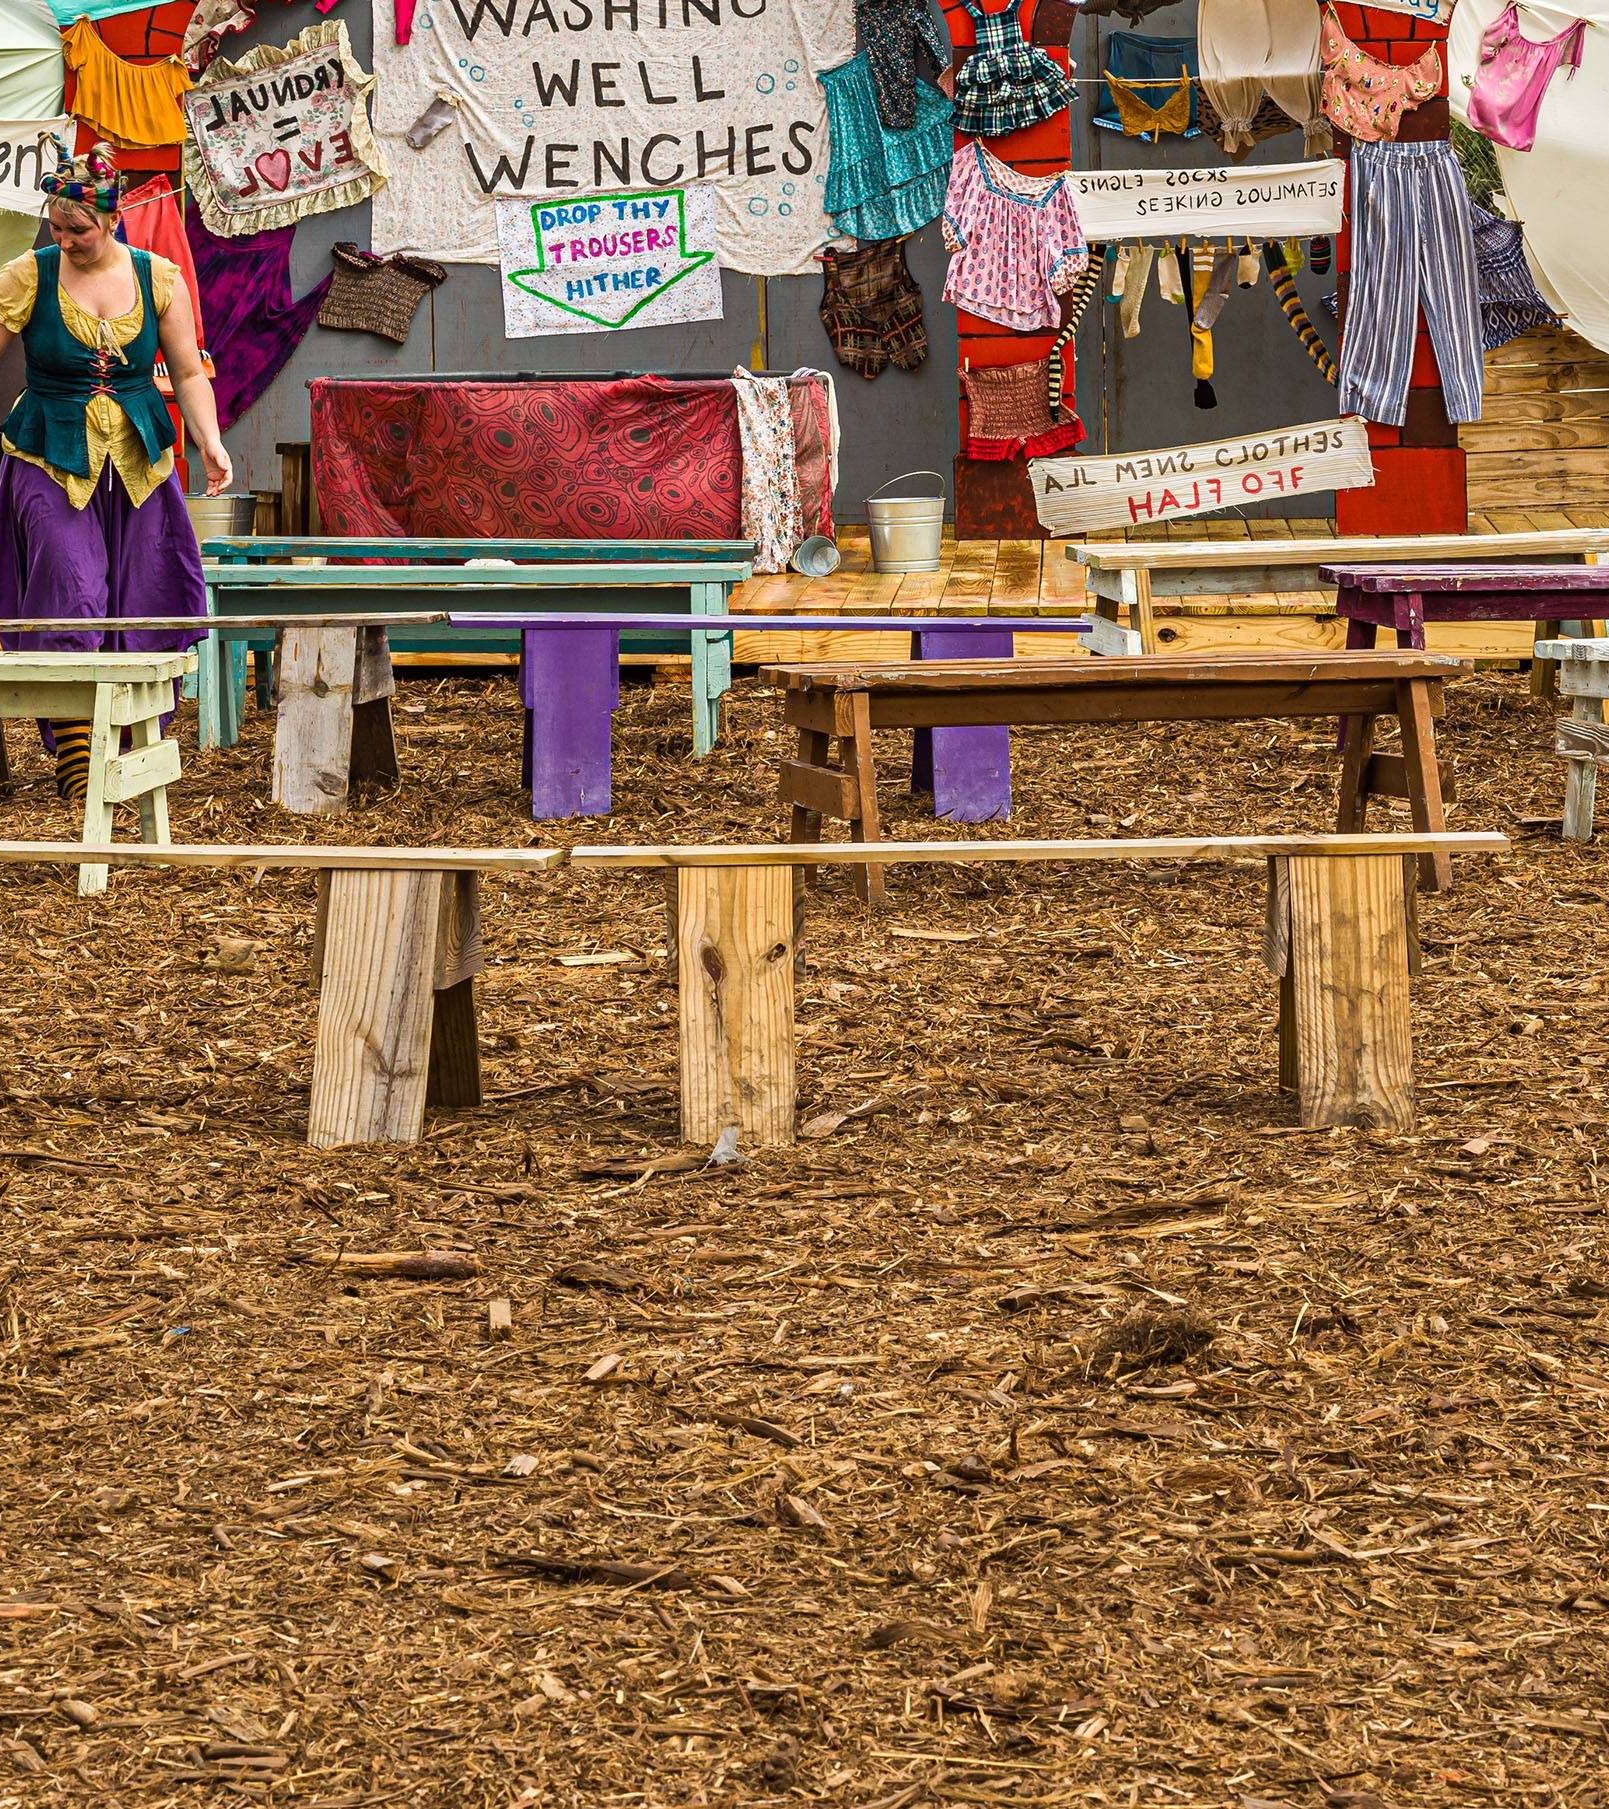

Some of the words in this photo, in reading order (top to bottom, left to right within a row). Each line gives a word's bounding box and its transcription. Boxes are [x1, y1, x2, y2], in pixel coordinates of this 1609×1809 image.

[532, 56, 725, 107] WELL
[464, 120, 815, 194] WENCHES
[1079, 173, 1144, 194] SINGLE
[1165, 169, 1228, 188] SOCKS
[1136, 191, 1224, 217] SEEKING
[1235, 180, 1338, 206] SOULMATES
[540, 204, 601, 231] DROP
[612, 199, 670, 221] THY
[548, 225, 679, 264] TROUSERS
[566, 266, 663, 301] HITHER
[1115, 450, 1195, 483] MENS
[1214, 429, 1344, 467] CLOTHES
[1127, 478, 1222, 523] HALF
[1241, 465, 1304, 494] OFF
